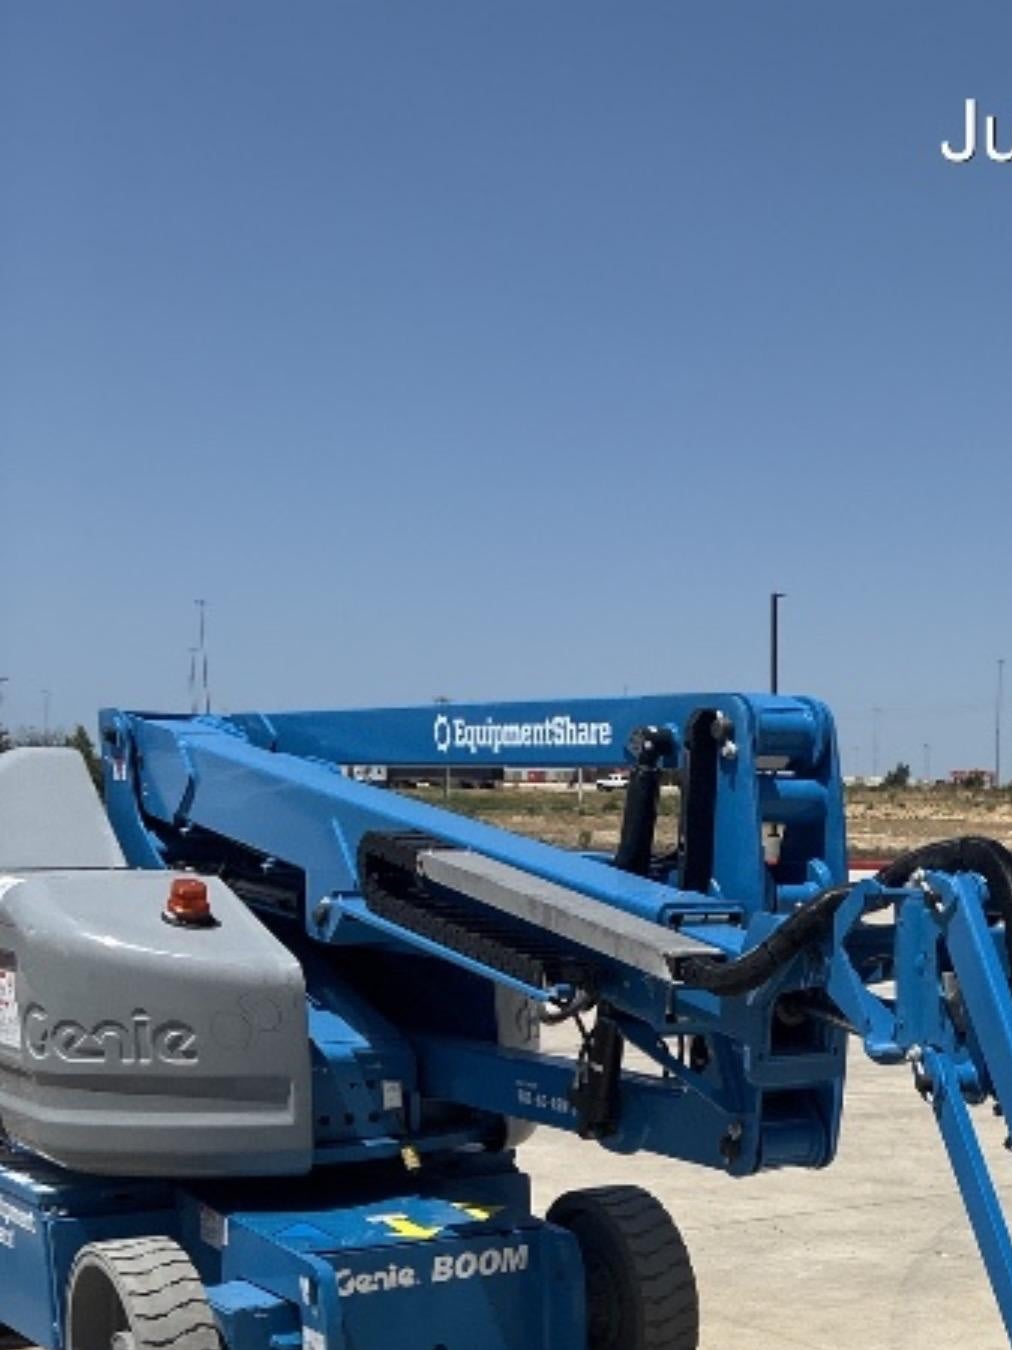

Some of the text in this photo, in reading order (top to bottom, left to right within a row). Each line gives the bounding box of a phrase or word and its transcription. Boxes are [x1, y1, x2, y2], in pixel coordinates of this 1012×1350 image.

[452, 716, 613, 754] EquipmentShare
[23, 1002, 200, 1065] Genie
[335, 1245, 530, 1297] Genie BOOM
